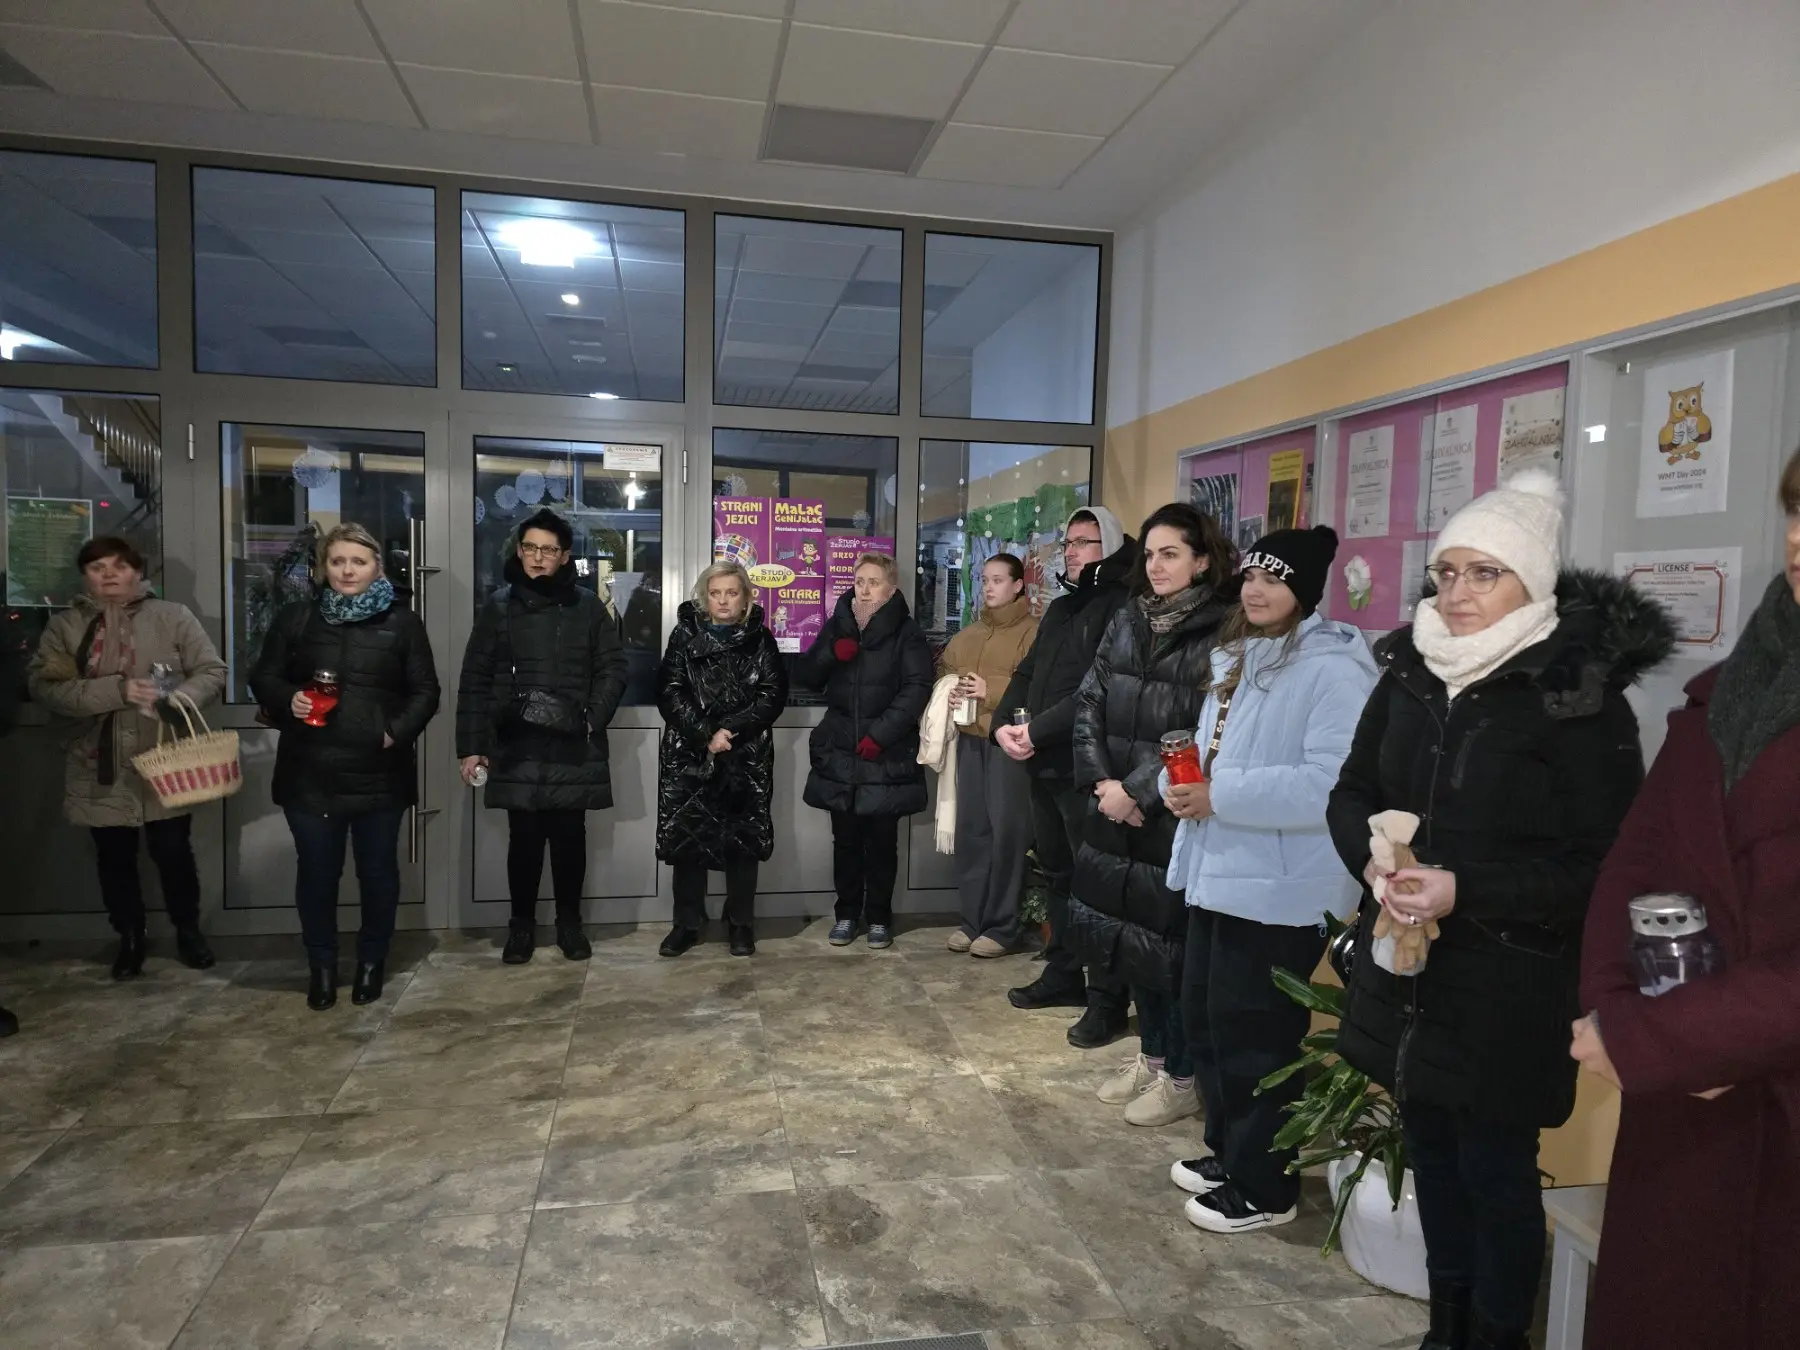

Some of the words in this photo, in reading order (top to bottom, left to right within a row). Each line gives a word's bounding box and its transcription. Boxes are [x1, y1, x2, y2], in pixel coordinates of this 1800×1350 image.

[720, 501, 763, 512] STRANI
[725, 514, 758, 526] JEZICI
[832, 551, 854, 559] BRZO
[761, 568, 792, 576] STUDIO
[1657, 564, 1690, 573] LICENSE
[778, 589, 821, 600] GITARA
